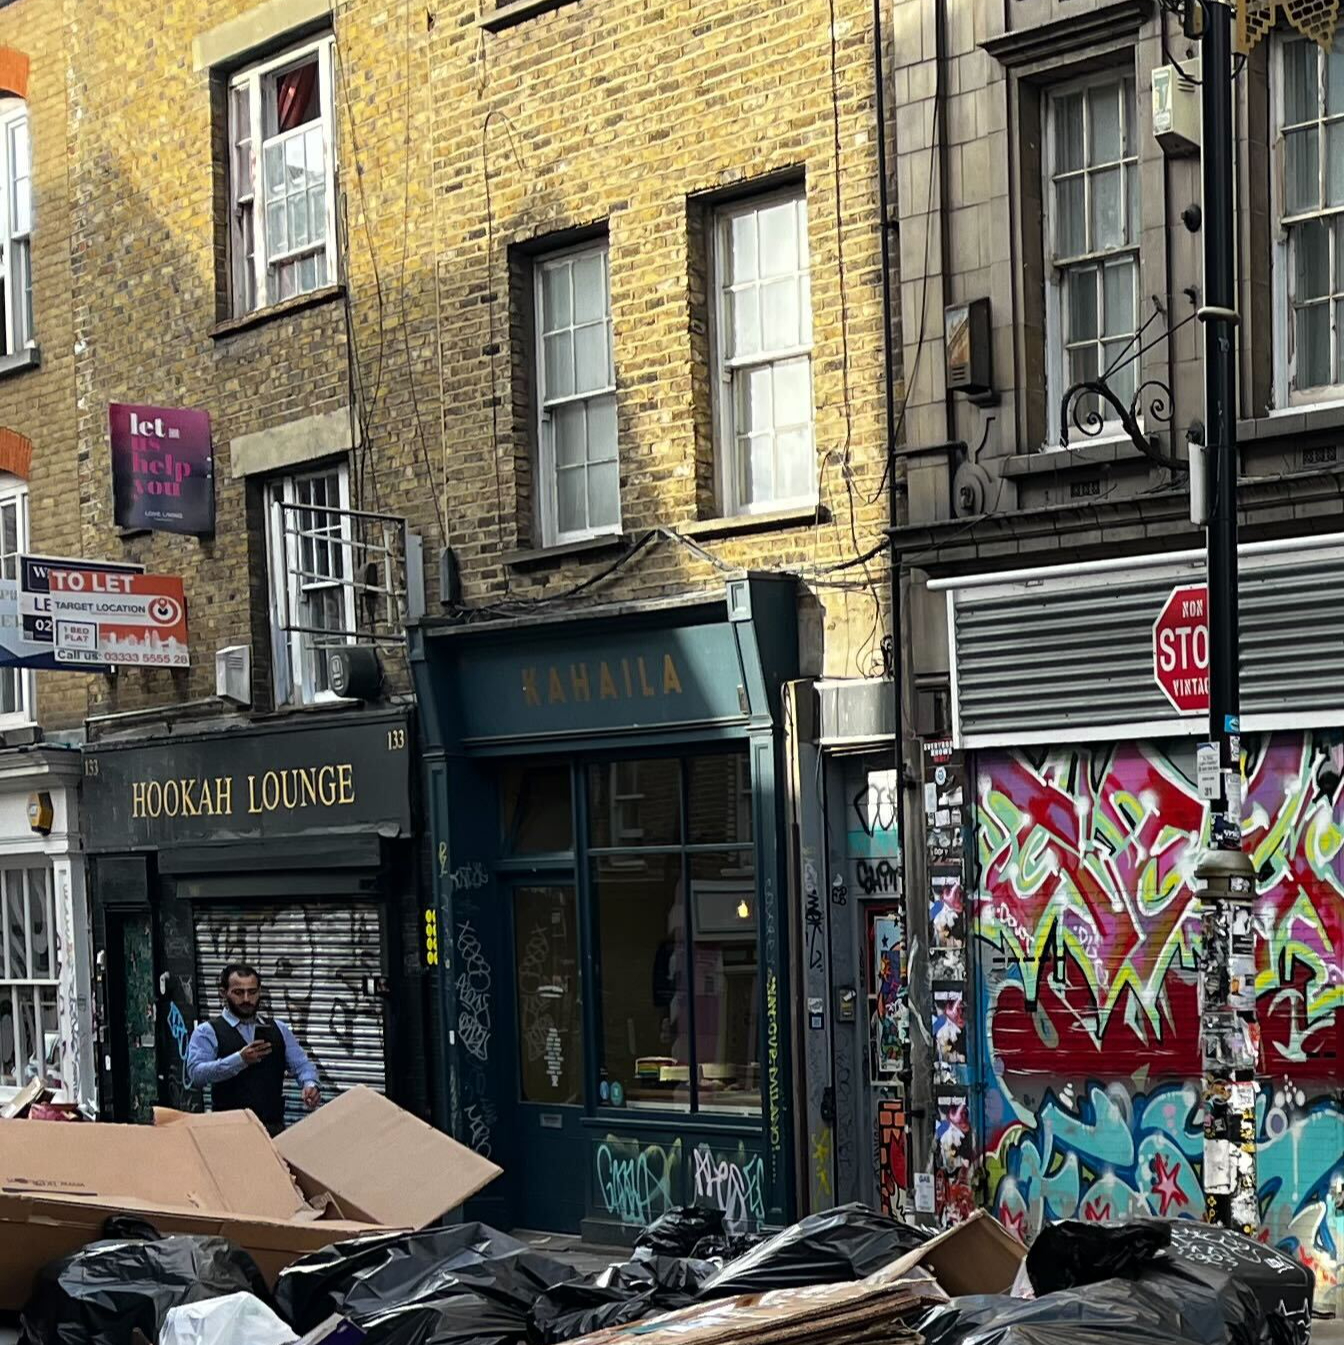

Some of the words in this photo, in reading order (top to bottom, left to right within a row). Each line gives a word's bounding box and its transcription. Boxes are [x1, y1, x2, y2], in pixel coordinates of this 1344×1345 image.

[132, 454, 191, 483] help
[131, 479, 180, 502] you
[52, 572, 84, 591] TO
[92, 573, 134, 593] LET
[55, 601, 93, 612] TARGET
[96, 603, 146, 614] LOCATION
[1182, 599, 1204, 619] NON
[64, 634, 89, 643] FLAT
[70, 626, 90, 635] BED
[57, 650, 81, 661] Call
[105, 653, 139, 662] 03333
[143, 653, 171, 664] 5555
[1159, 625, 1209, 672] STO
[521, 654, 683, 707] KAHAILA
[1173, 676, 1209, 697] VINTA
[387, 730, 405, 750] 133
[84, 759, 99, 776] 133
[131, 777, 232, 818] HOOKAH
[248, 764, 356, 814] LOUNGE
